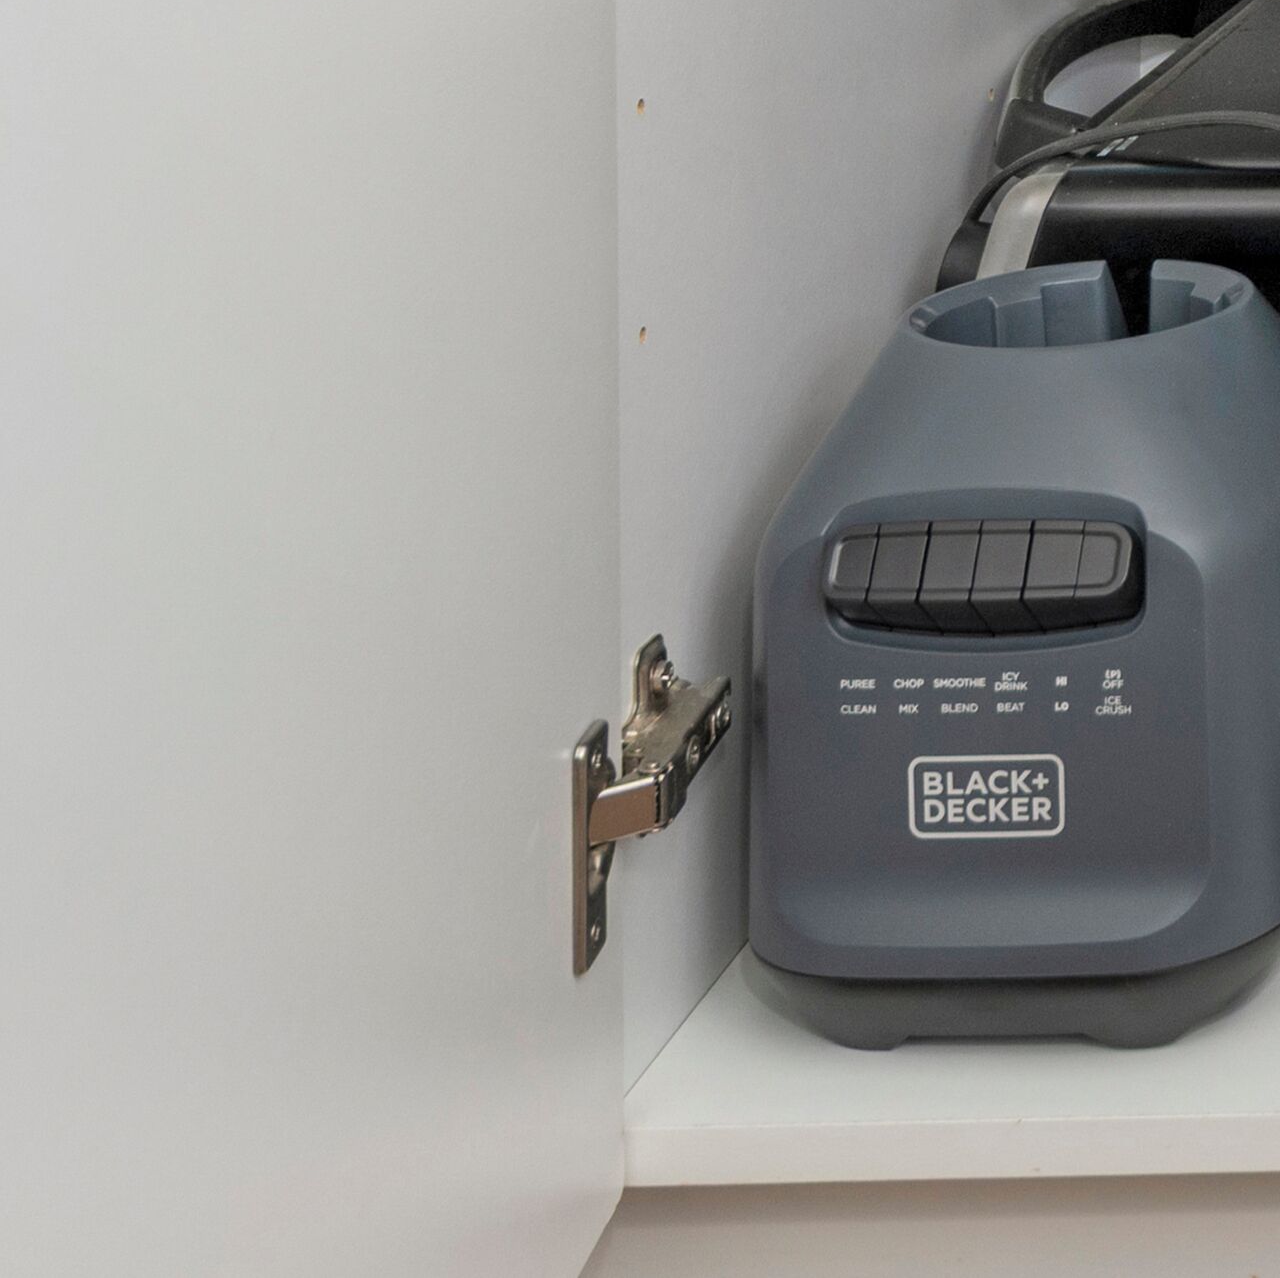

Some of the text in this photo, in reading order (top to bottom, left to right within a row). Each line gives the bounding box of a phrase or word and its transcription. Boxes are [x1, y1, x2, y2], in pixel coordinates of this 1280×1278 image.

[1002, 671, 1021, 682] ICY
[1055, 675, 1068, 687] HI
[840, 678, 876, 690] PUREE
[893, 678, 925, 689] CHOP
[933, 677, 987, 689] SMOOTHIE
[994, 681, 1028, 692] DRINK
[1102, 679, 1124, 690] OFF
[1104, 695, 1122, 706] ICE
[840, 704, 877, 715] CLEAN
[899, 703, 919, 714] MIX
[941, 702, 979, 714] BLEND
[996, 702, 1025, 713] BEAT
[1054, 701, 1070, 712] LO
[1095, 705, 1132, 715] CRUSH
[922, 769, 1050, 796] BLACK+
[923, 796, 1053, 823] DECKER
